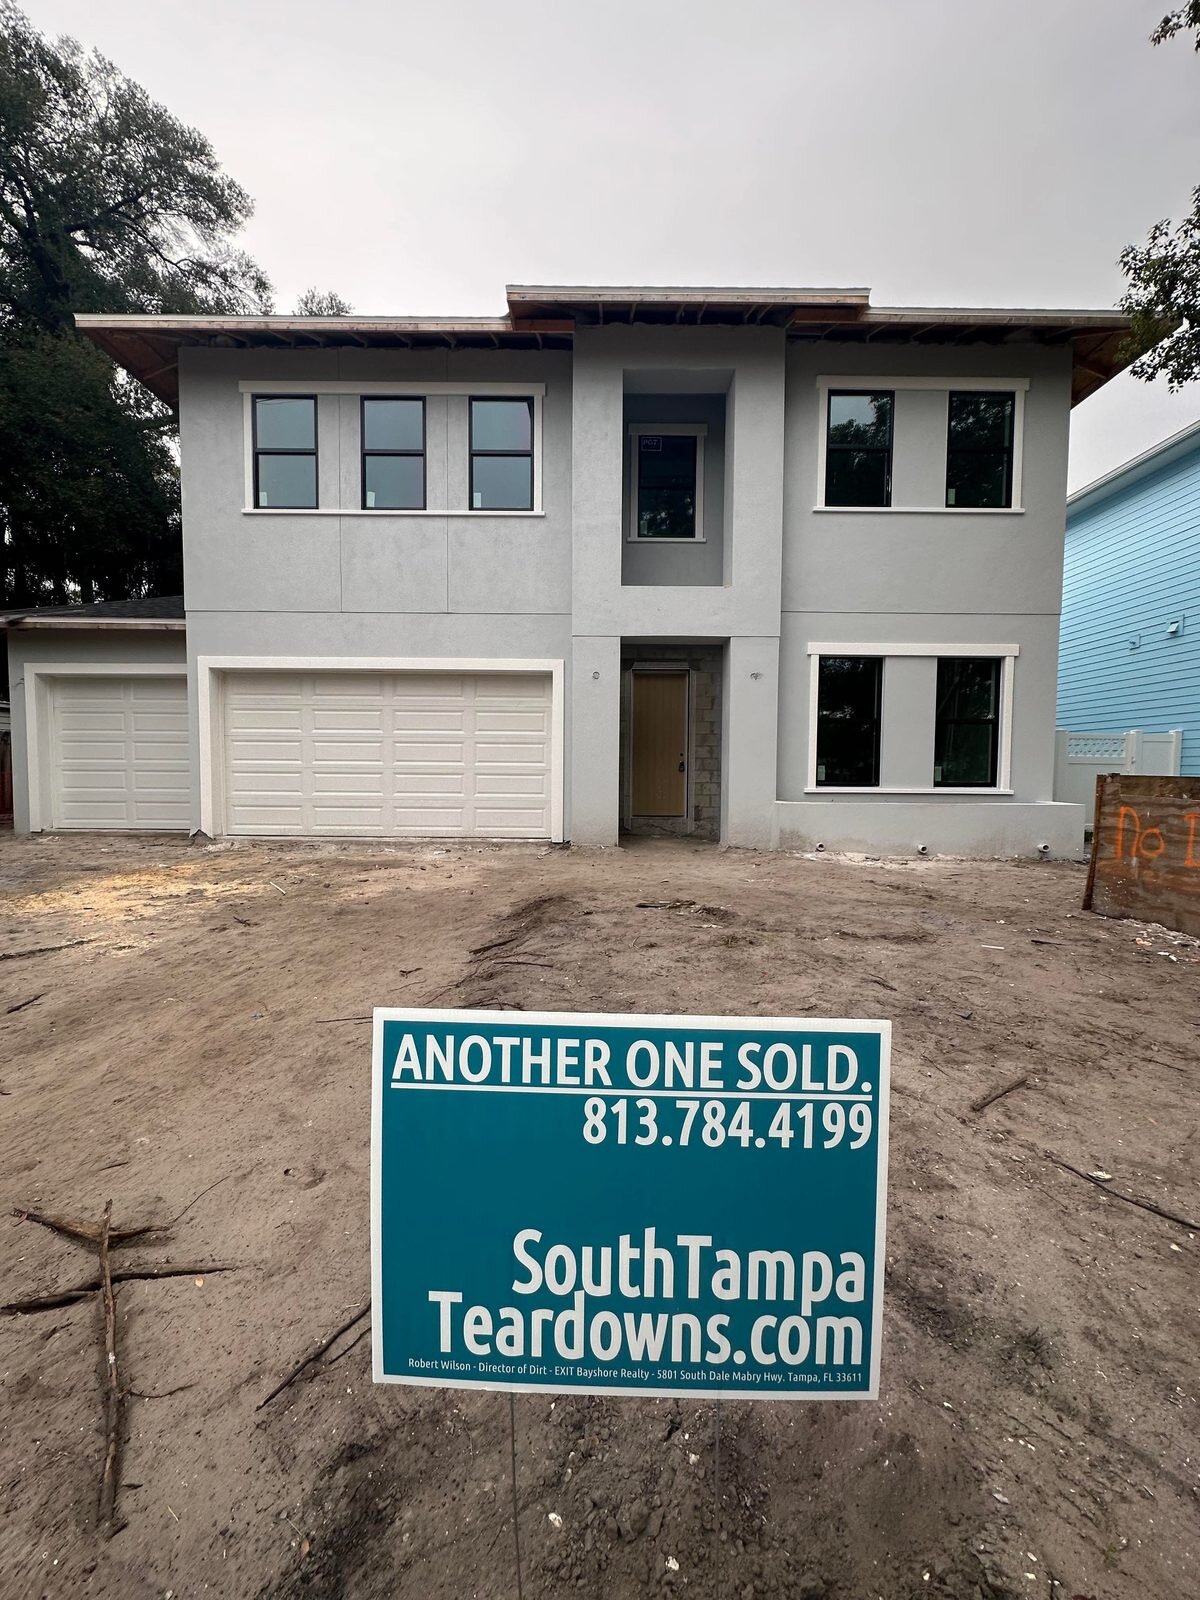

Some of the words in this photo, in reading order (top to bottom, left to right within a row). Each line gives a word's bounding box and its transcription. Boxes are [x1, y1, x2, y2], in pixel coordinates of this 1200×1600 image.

[392, 1034, 612, 1086] ANOTHER
[626, 1040, 724, 1089] ONE
[737, 1043, 872, 1093] SOLD.
[583, 1097, 872, 1150] 813.784.4199
[512, 1227, 866, 1317] SouthTampa
[429, 1290, 863, 1366] Teardowns.com
[409, 1358, 439, 1369] Robert
[440, 1360, 471, 1371] Wilson
[478, 1362, 515, 1373] Director
[517, 1363, 528, 1374] of
[529, 1364, 547, 1375] Dirt
[554, 1366, 574, 1376] EXIT
[576, 1366, 618, 1379] Bayshore
[620, 1368, 650, 1380] Realty
[657, 1369, 677, 1380] 5801
[680, 1370, 707, 1380] South
[709, 1370, 730, 1381] Dale
[732, 1371, 762, 1383] Mabry
[763, 1372, 786, 1383] Hwy.
[787, 1372, 821, 1384] Tampa,
[823, 1372, 834, 1382] FL
[836, 1372, 862, 1382] 33611
